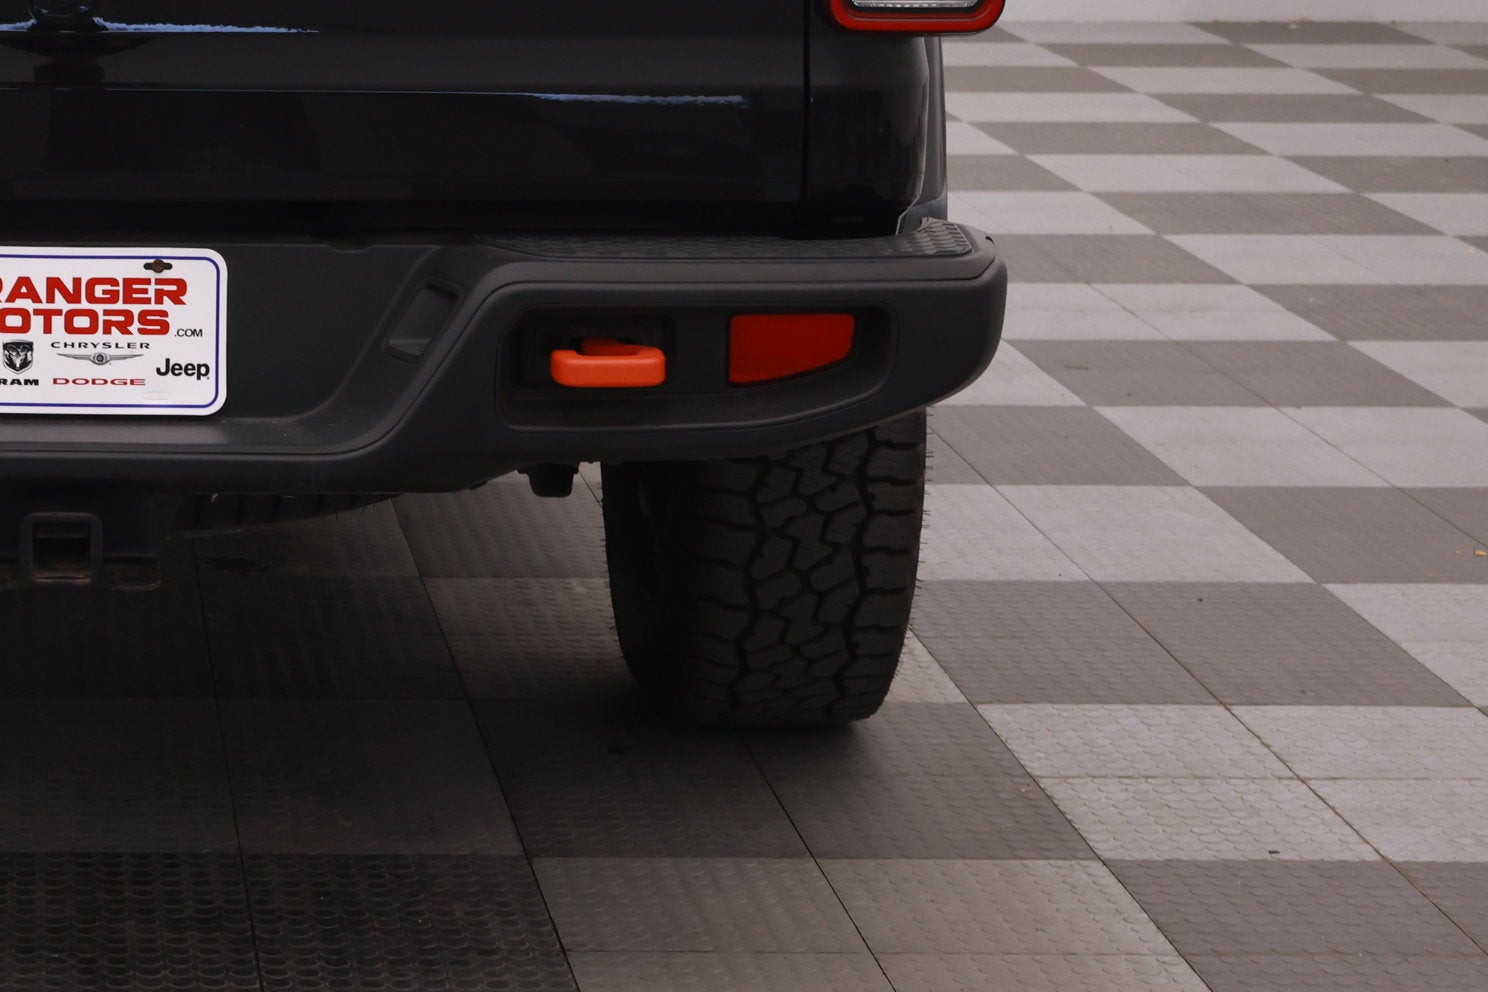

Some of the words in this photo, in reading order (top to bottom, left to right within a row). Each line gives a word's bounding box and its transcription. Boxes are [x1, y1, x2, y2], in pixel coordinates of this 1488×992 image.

[174, 328, 204, 338] .COM
[50, 341, 151, 350] CHRYSLER
[156, 358, 210, 381] Jeep
[52, 378, 147, 387] DODGE
